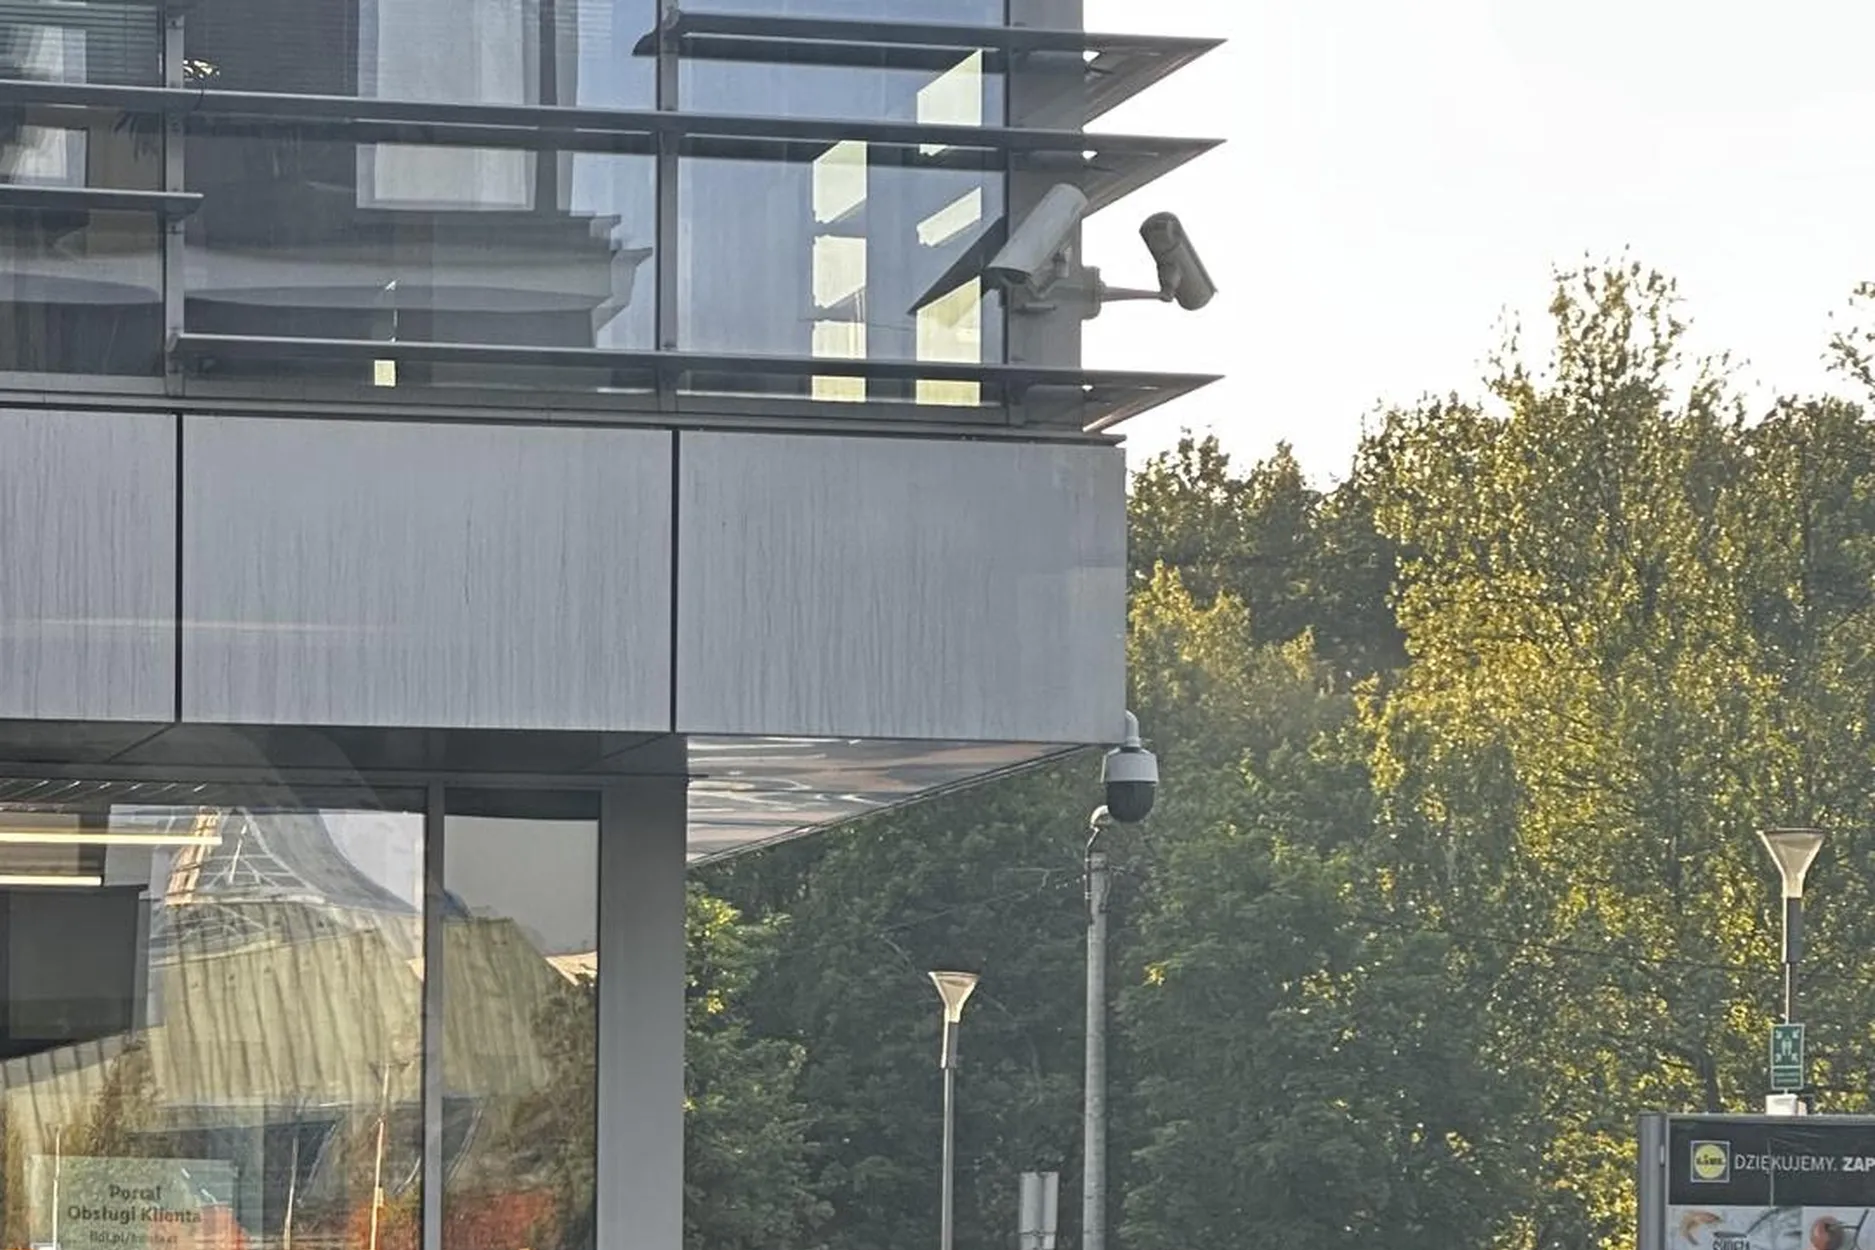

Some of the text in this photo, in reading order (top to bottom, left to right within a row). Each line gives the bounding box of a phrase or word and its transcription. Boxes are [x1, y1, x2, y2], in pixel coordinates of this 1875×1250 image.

[1734, 1153, 1837, 1174] DZIĘKUJEMY.
[109, 1185, 161, 1200] Portal
[68, 1206, 203, 1225] Obsługi Klienta
